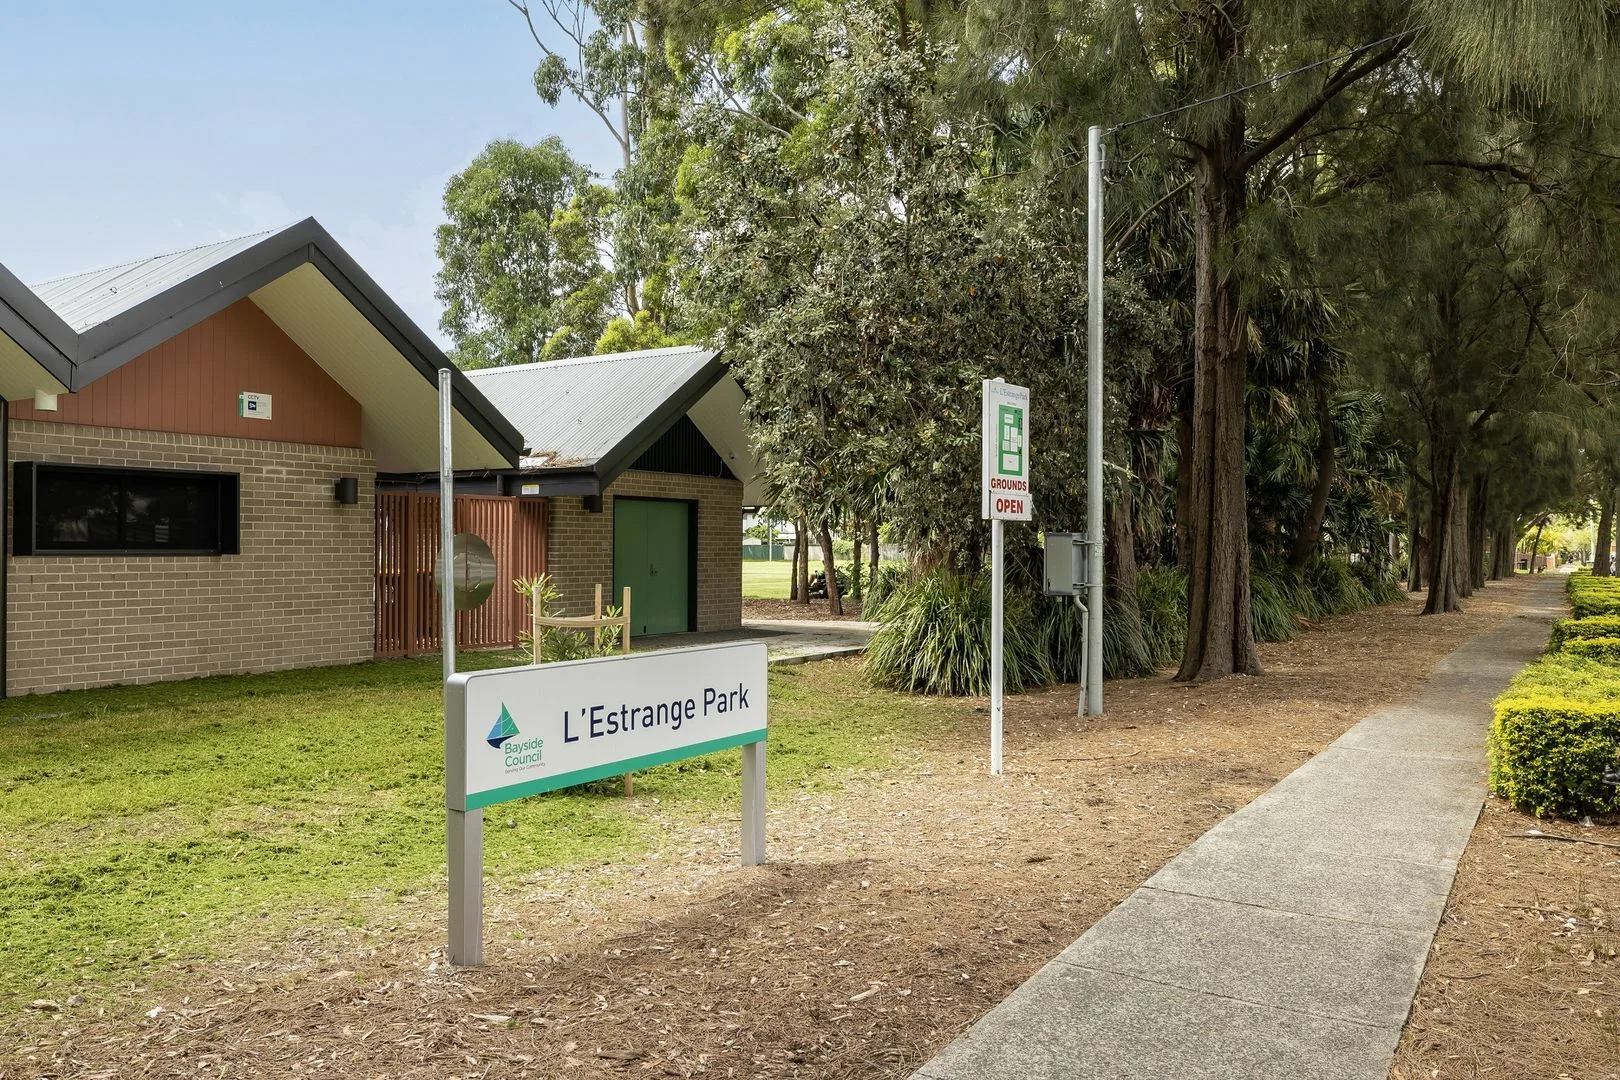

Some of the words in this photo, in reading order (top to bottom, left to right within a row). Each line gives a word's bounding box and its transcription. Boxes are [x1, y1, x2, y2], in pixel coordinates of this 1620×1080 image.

[991, 478, 1027, 491] GROUNDS
[996, 498, 1024, 514] OPEN
[564, 698, 696, 744] L'Estrange
[703, 683, 750, 717] Park
[505, 737, 544, 754] Bayside
[505, 750, 542, 767] Council
